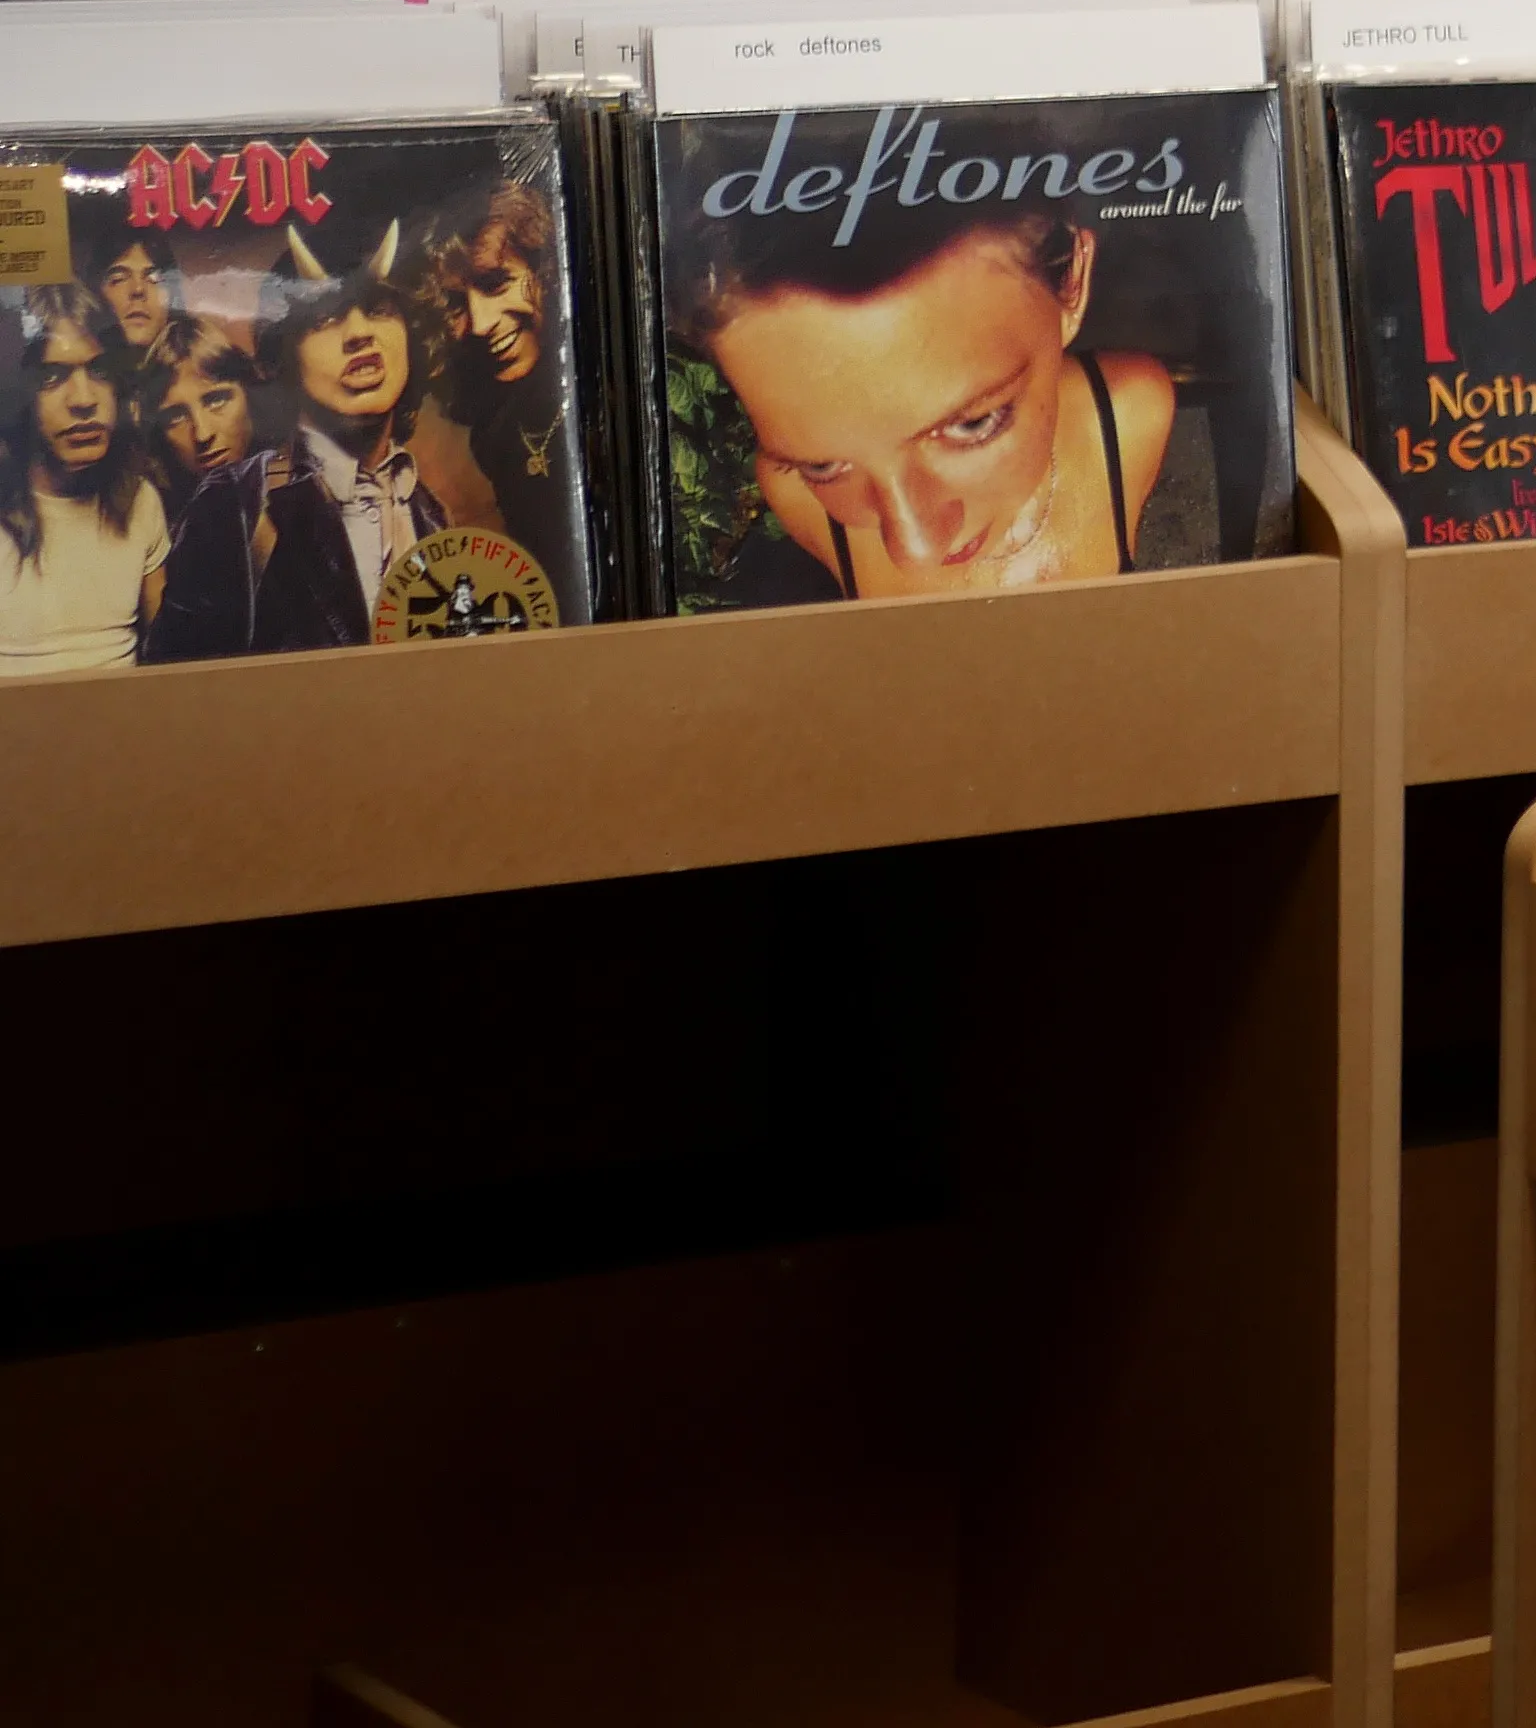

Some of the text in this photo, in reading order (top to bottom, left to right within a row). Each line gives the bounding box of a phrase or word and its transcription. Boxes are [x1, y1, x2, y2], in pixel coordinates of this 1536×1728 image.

[734, 35, 882, 59] rock deftones
[1342, 24, 1470, 49] JETHRO TULL
[1372, 117, 1505, 169] Jethro
[702, 105, 1185, 249] deftones
[1098, 182, 1243, 223] around the fur
[1395, 425, 1439, 475] Is
[469, 536, 530, 580] FIFTY
